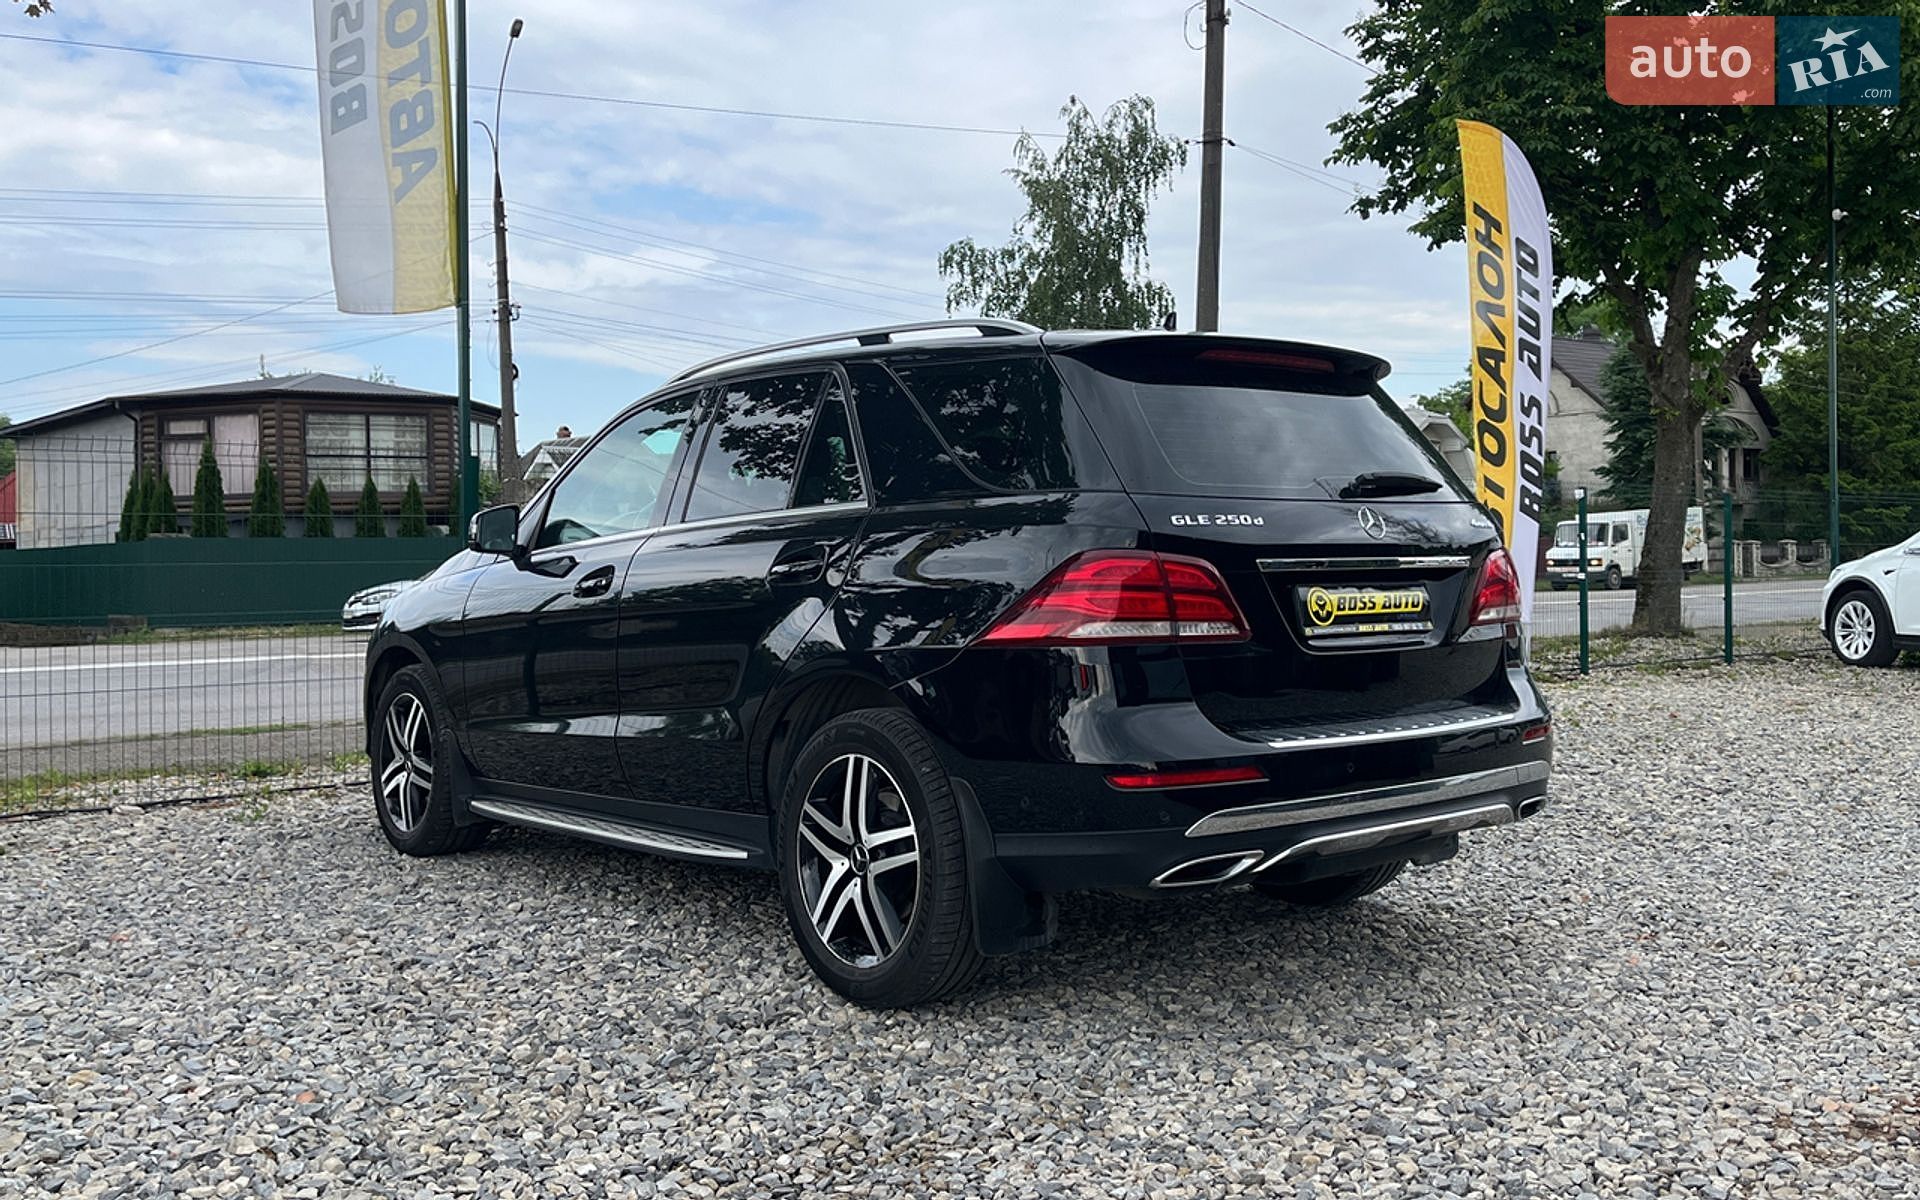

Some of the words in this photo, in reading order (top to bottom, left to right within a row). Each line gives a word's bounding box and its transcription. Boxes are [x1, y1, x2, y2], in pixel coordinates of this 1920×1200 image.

[1515, 236, 1542, 382] AUTO
[1519, 391, 1543, 525] BOSS
[1170, 514, 1211, 526] GLE
[1215, 514, 1264, 526] 250d
[1336, 594, 1376, 612] BOSS
[1381, 591, 1420, 609] AUTO
